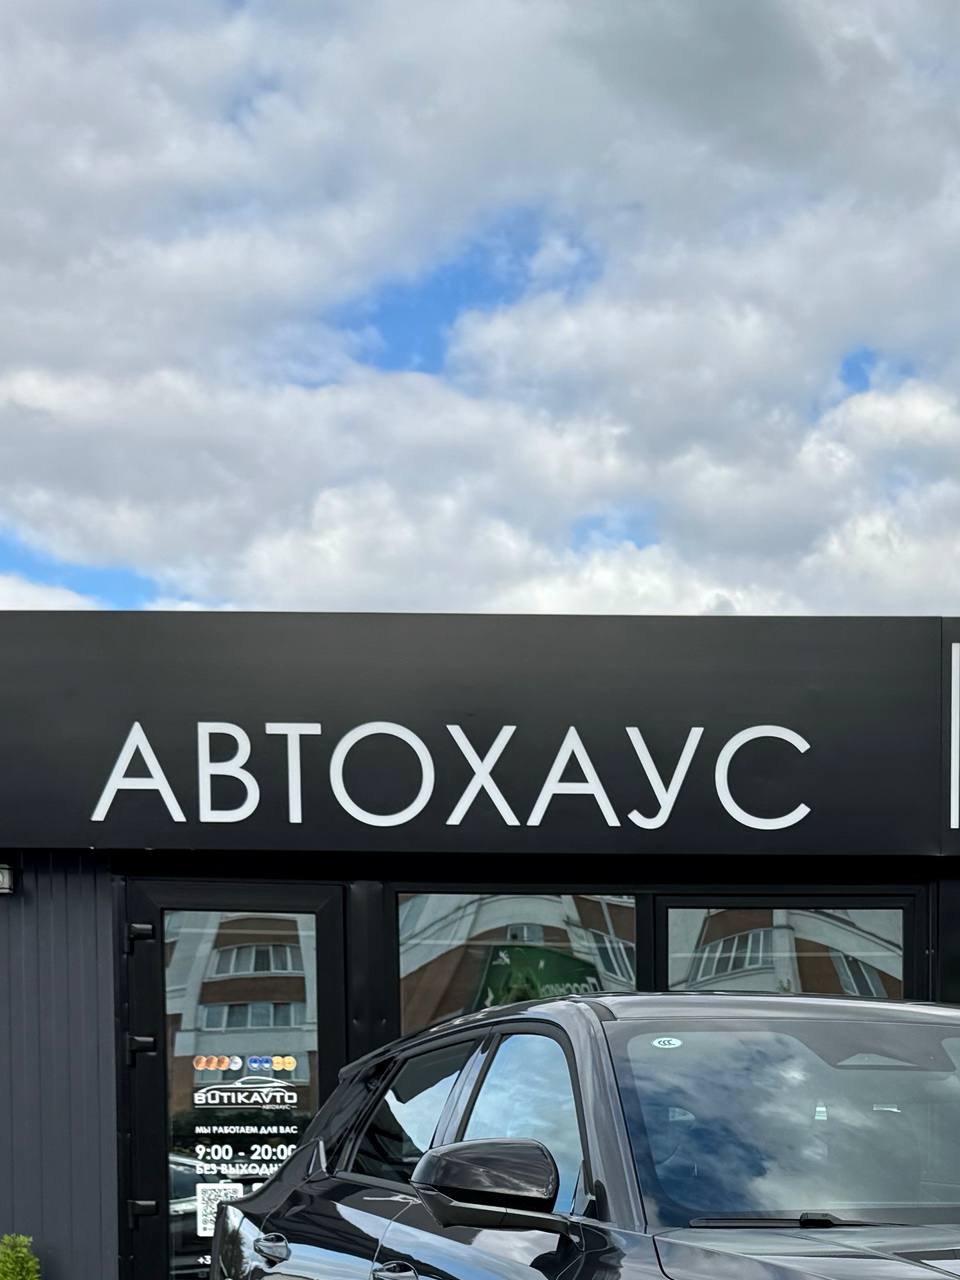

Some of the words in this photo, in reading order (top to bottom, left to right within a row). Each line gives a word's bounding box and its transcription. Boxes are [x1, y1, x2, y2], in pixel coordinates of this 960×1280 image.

[91, 721, 811, 830] АВТОХАУС
[194, 1091, 298, 1105] BUTIKAVTO
[194, 1126, 211, 1134] МЫ
[212, 1126, 258, 1134] РАБОТАЕМ
[260, 1126, 278, 1134] ДЛЯ
[279, 1126, 298, 1134] ВАС
[195, 1145, 233, 1160] 9:00
[196, 1164, 217, 1174] БЕЗ
[220, 1163, 281, 1176] ВЫХОДН
